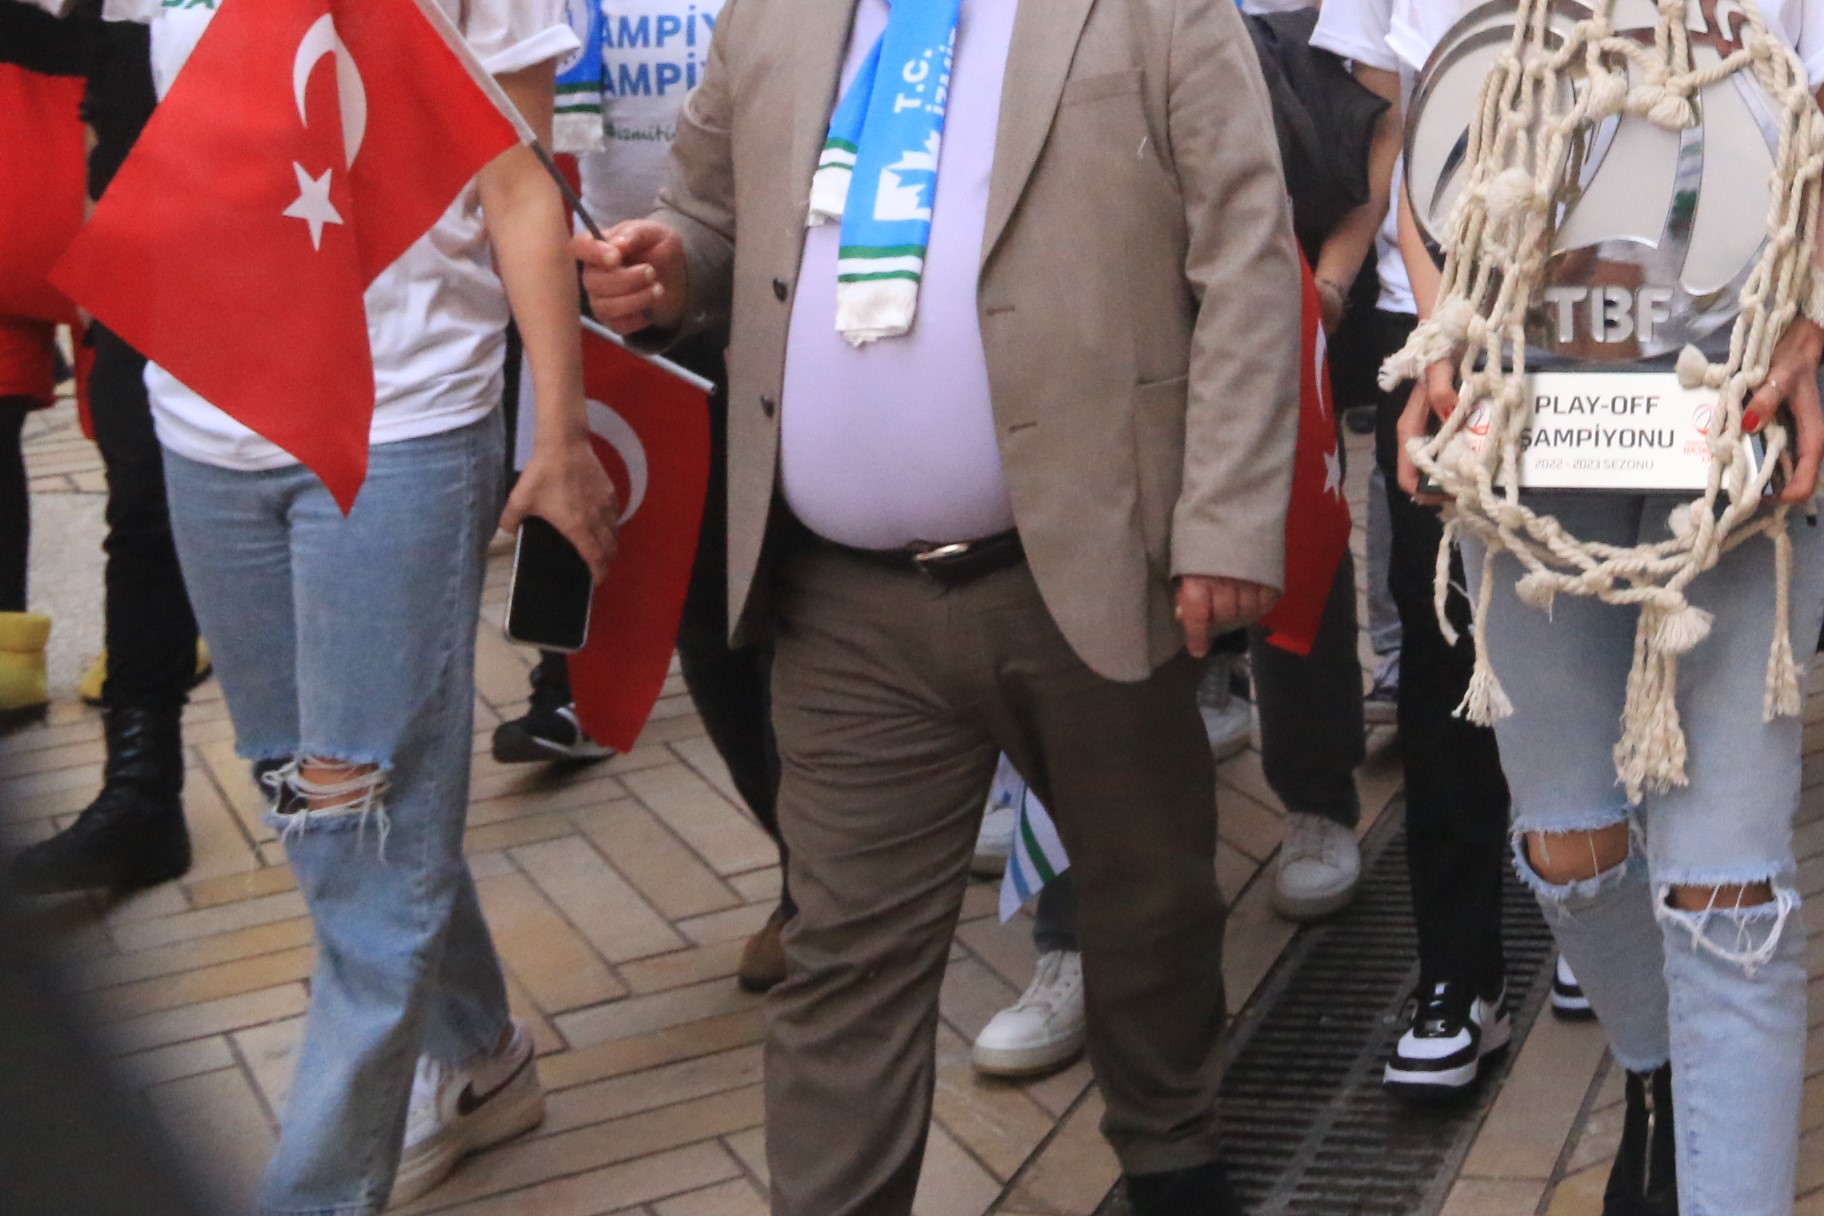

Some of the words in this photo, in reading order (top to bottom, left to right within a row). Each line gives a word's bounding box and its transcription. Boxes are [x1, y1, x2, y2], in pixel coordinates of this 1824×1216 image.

[1545, 285, 1675, 344] TBF
[1534, 394, 1661, 415] PLAY-OFF
[1602, 459, 1655, 471] SEZONU
